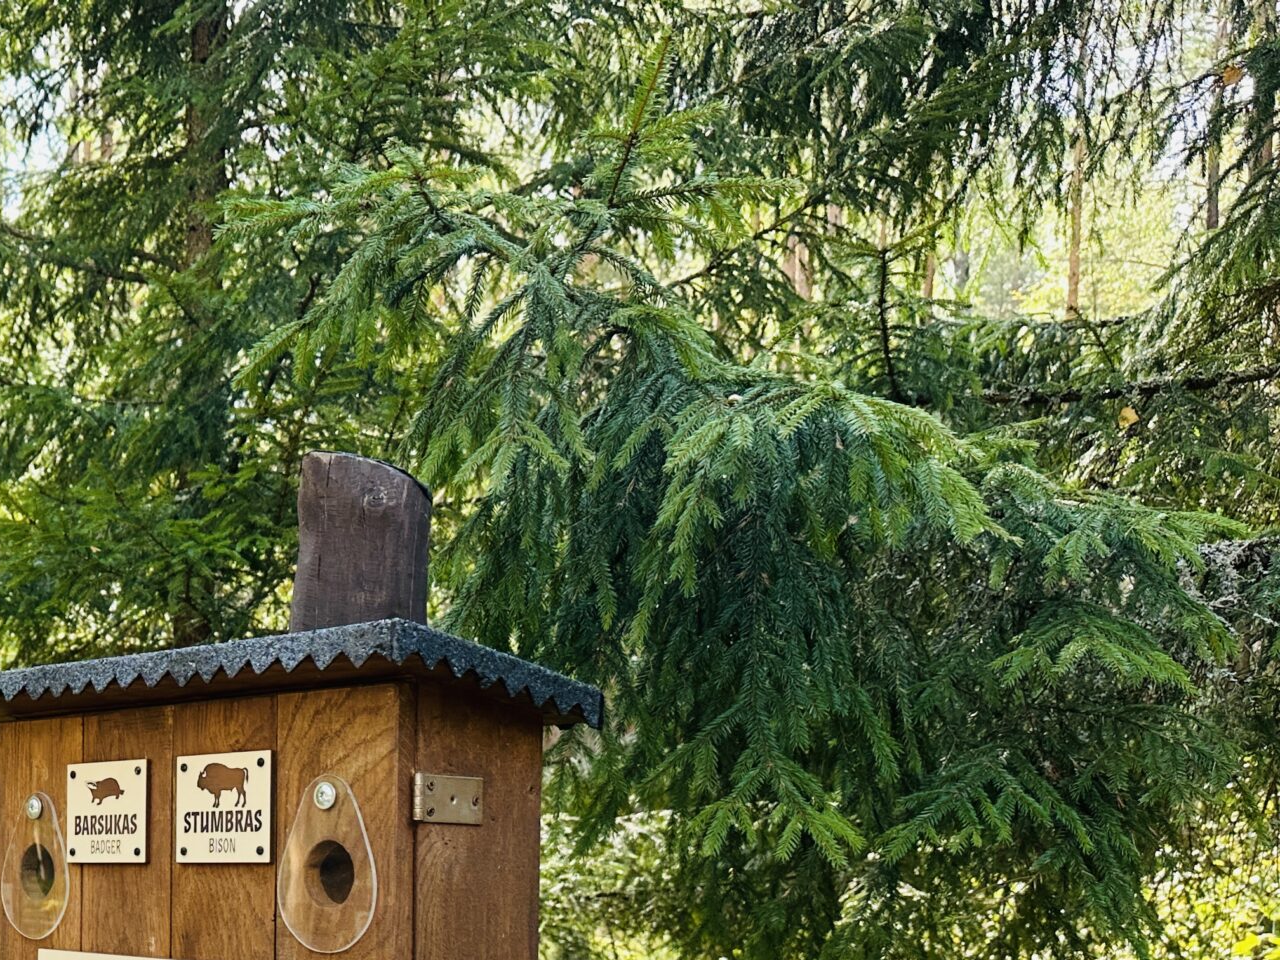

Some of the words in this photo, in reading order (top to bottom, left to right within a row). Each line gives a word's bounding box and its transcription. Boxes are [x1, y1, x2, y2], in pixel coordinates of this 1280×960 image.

[74, 813, 138, 836] BARSUKAS
[183, 809, 263, 833] STUMBRAS
[90, 839, 122, 855] BADGER
[208, 837, 236, 854] BISON
